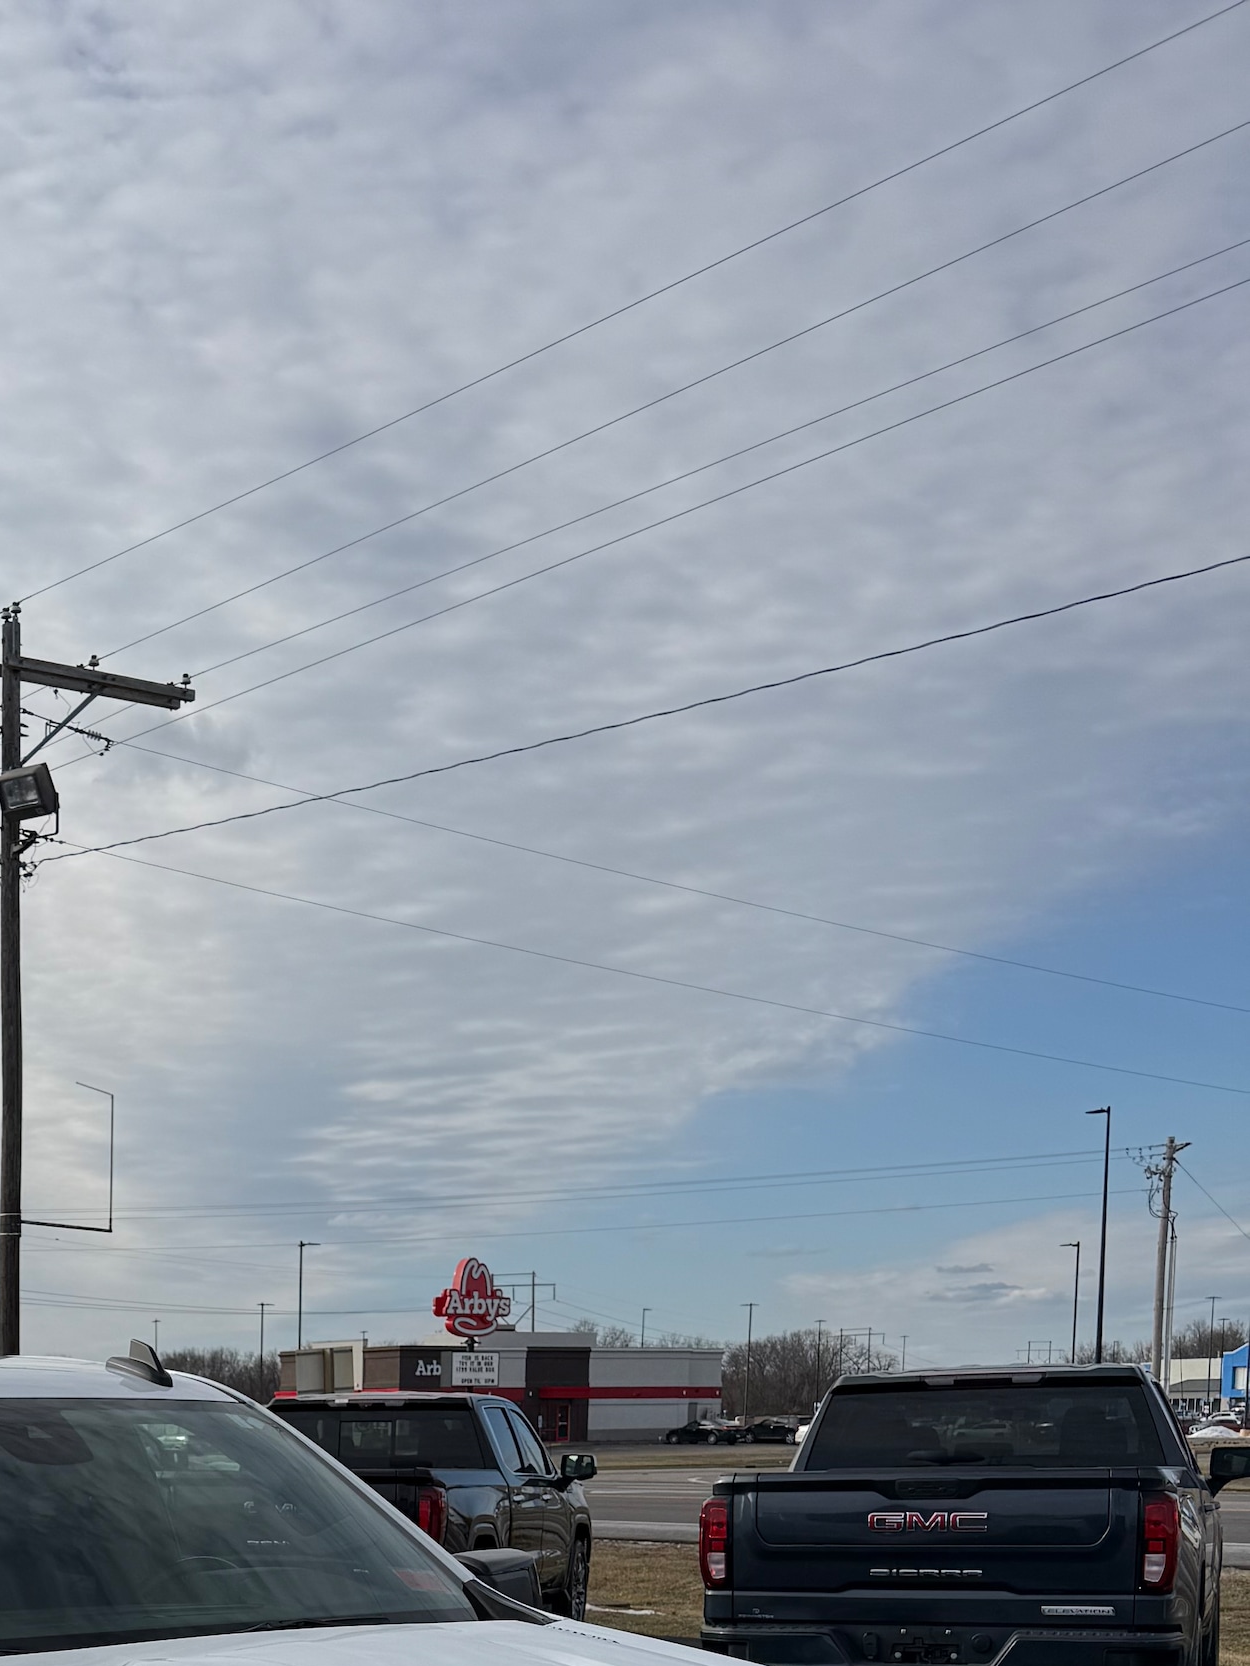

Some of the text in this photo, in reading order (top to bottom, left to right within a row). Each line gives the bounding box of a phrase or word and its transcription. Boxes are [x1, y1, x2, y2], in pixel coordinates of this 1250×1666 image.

[447, 1290, 510, 1321] Arby's
[867, 1511, 988, 1533] GMC
[869, 1568, 983, 1578] SIERRA
[1042, 1607, 1116, 1616] ELEVATION
